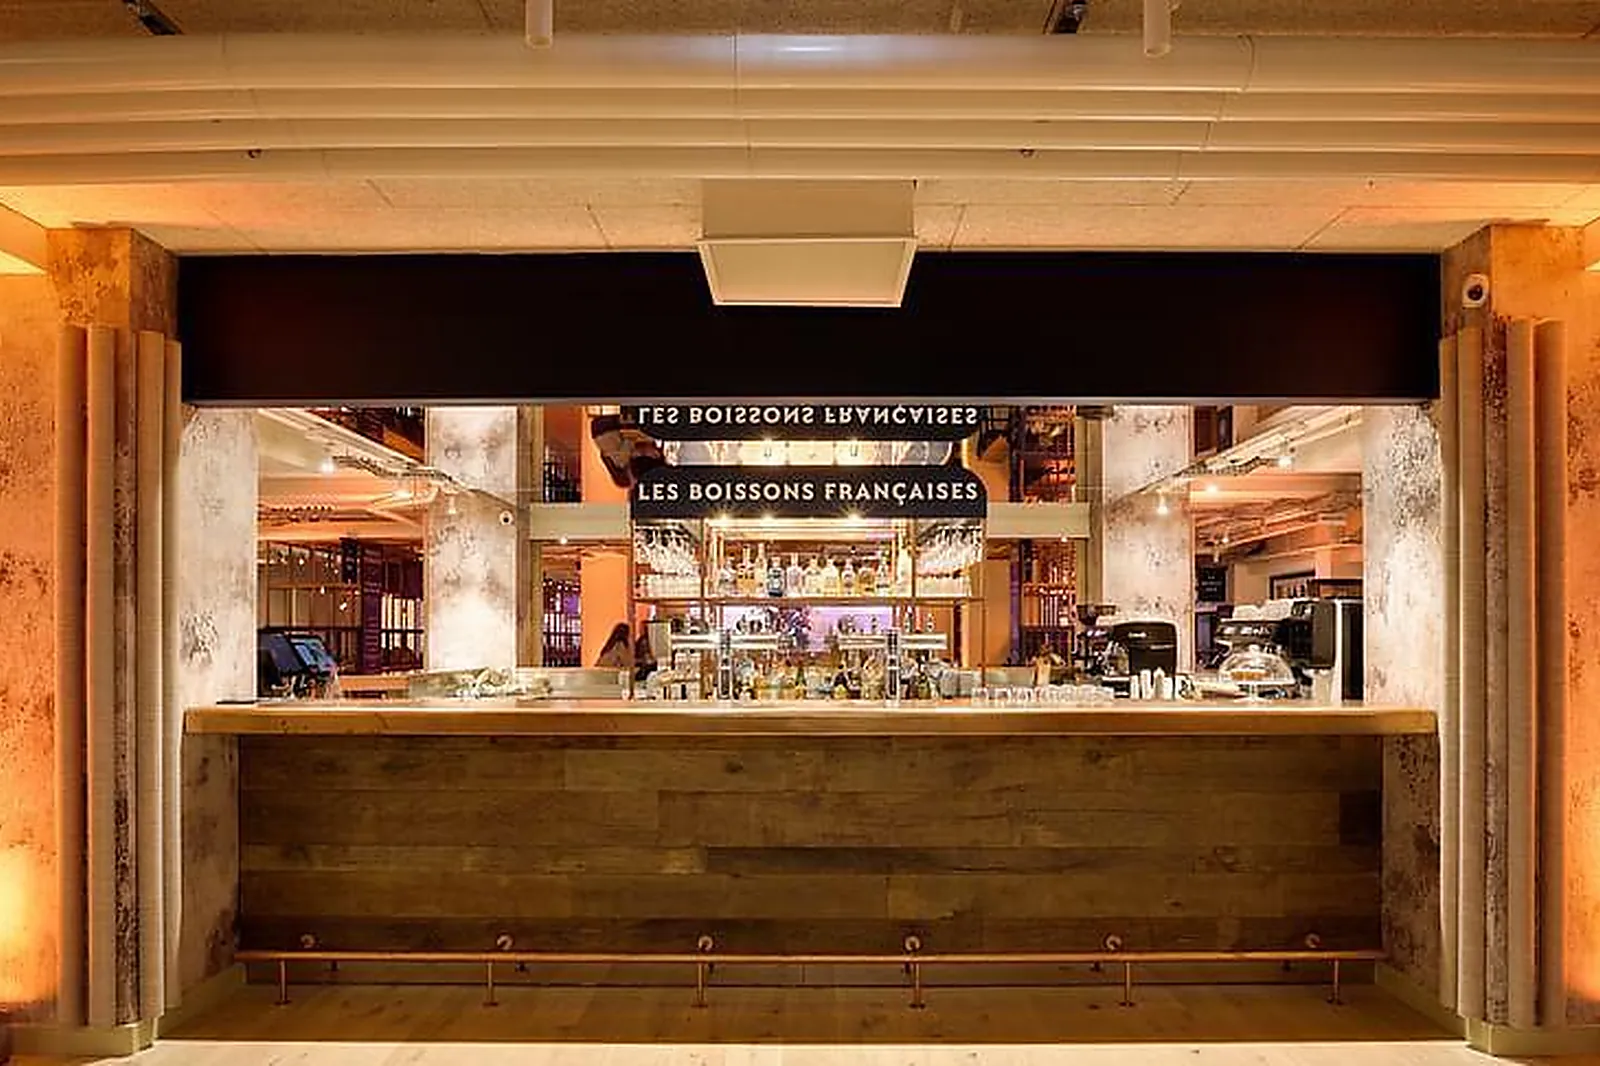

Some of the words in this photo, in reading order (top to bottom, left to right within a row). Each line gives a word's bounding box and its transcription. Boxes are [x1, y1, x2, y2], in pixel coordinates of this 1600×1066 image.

[638, 482, 678, 501] LES
[689, 482, 814, 501] BOISSONS
[824, 482, 978, 506] FRANÇAISES
